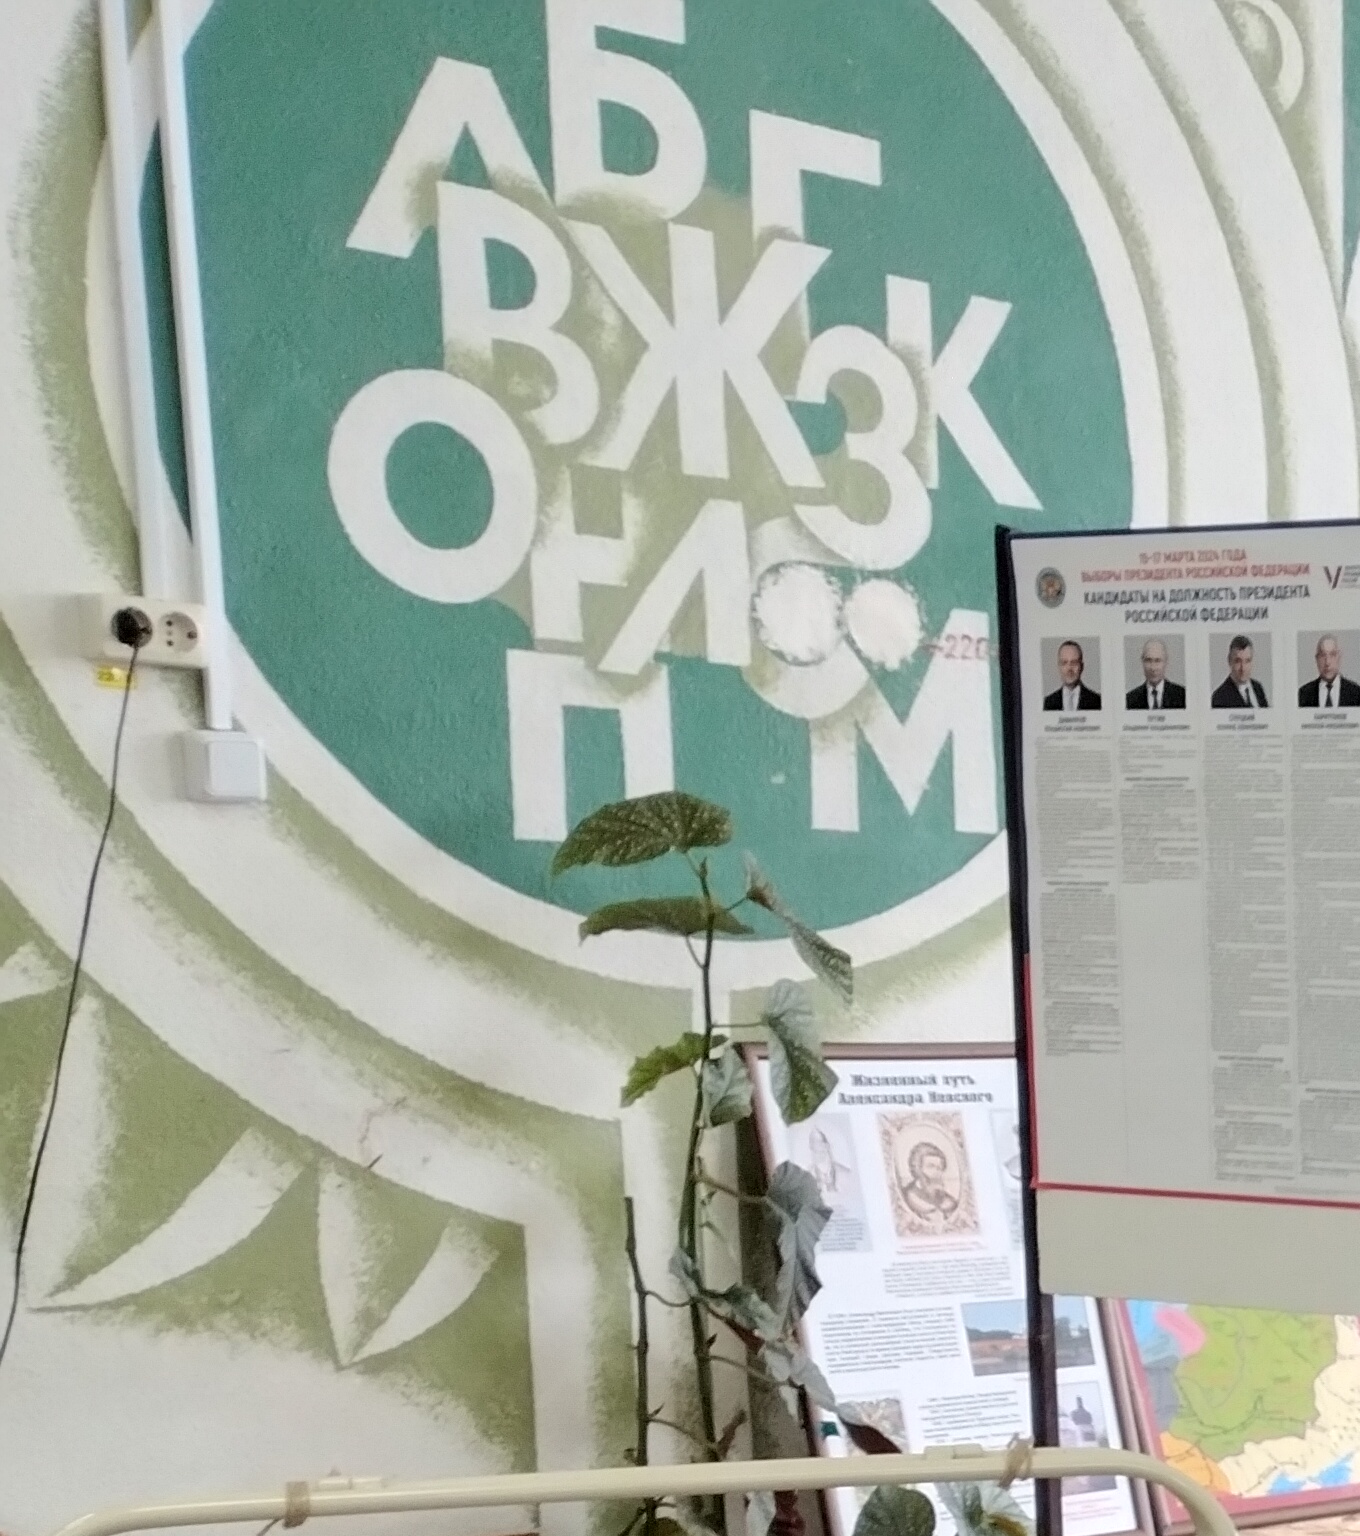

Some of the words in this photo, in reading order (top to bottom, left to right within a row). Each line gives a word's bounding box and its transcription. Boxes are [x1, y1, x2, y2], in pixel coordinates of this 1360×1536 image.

[545, 0, 707, 221] Б
[437, 180, 600, 445] В
[564, 216, 833, 488] Ж
[887, 273, 1043, 511] К
[327, 368, 538, 604] О
[785, 325, 932, 570] З
[1084, 590, 1149, 605] КАНДИДАТЫ
[1152, 590, 1166, 602] НА
[1168, 587, 1237, 604] ДОЛЖНОСТЬ
[1239, 585, 1310, 600] ПРЕЗИДЕНТА
[1125, 605, 1197, 623] РОССИЙСКОЙ
[1200, 607, 1268, 622] ФЕДЕРАЦИИ
[506, 649, 674, 841] П
[811, 609, 997, 834] М
